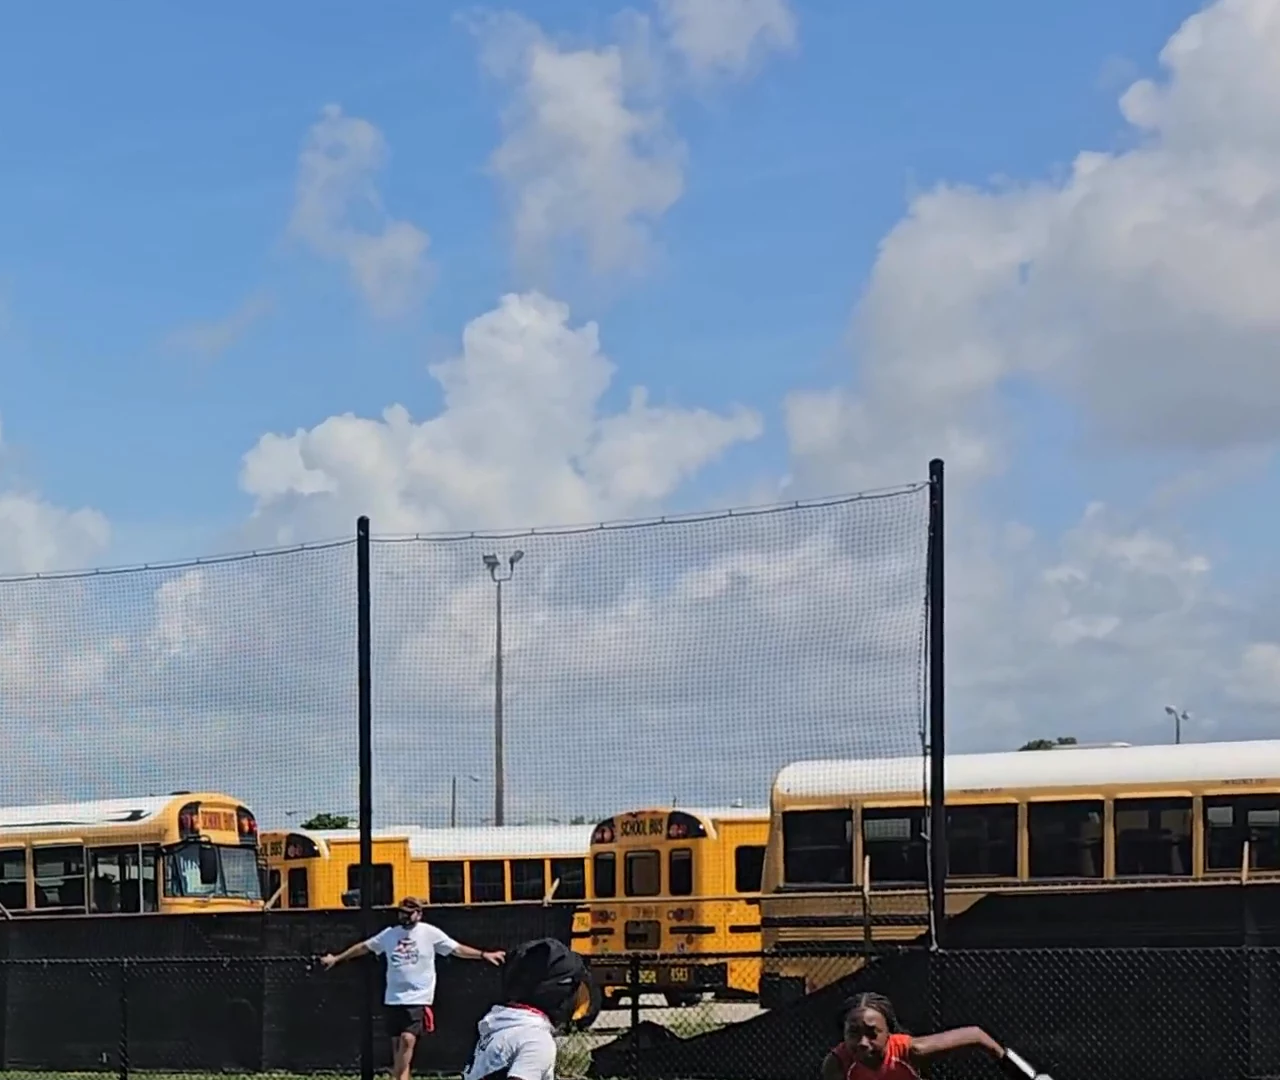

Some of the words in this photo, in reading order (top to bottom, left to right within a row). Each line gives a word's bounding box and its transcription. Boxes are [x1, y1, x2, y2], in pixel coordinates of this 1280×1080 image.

[200, 810, 220, 830] SCHOOL
[222, 812, 236, 831] BUS
[620, 820, 647, 836] SCHOOL
[649, 818, 663, 834] BUS
